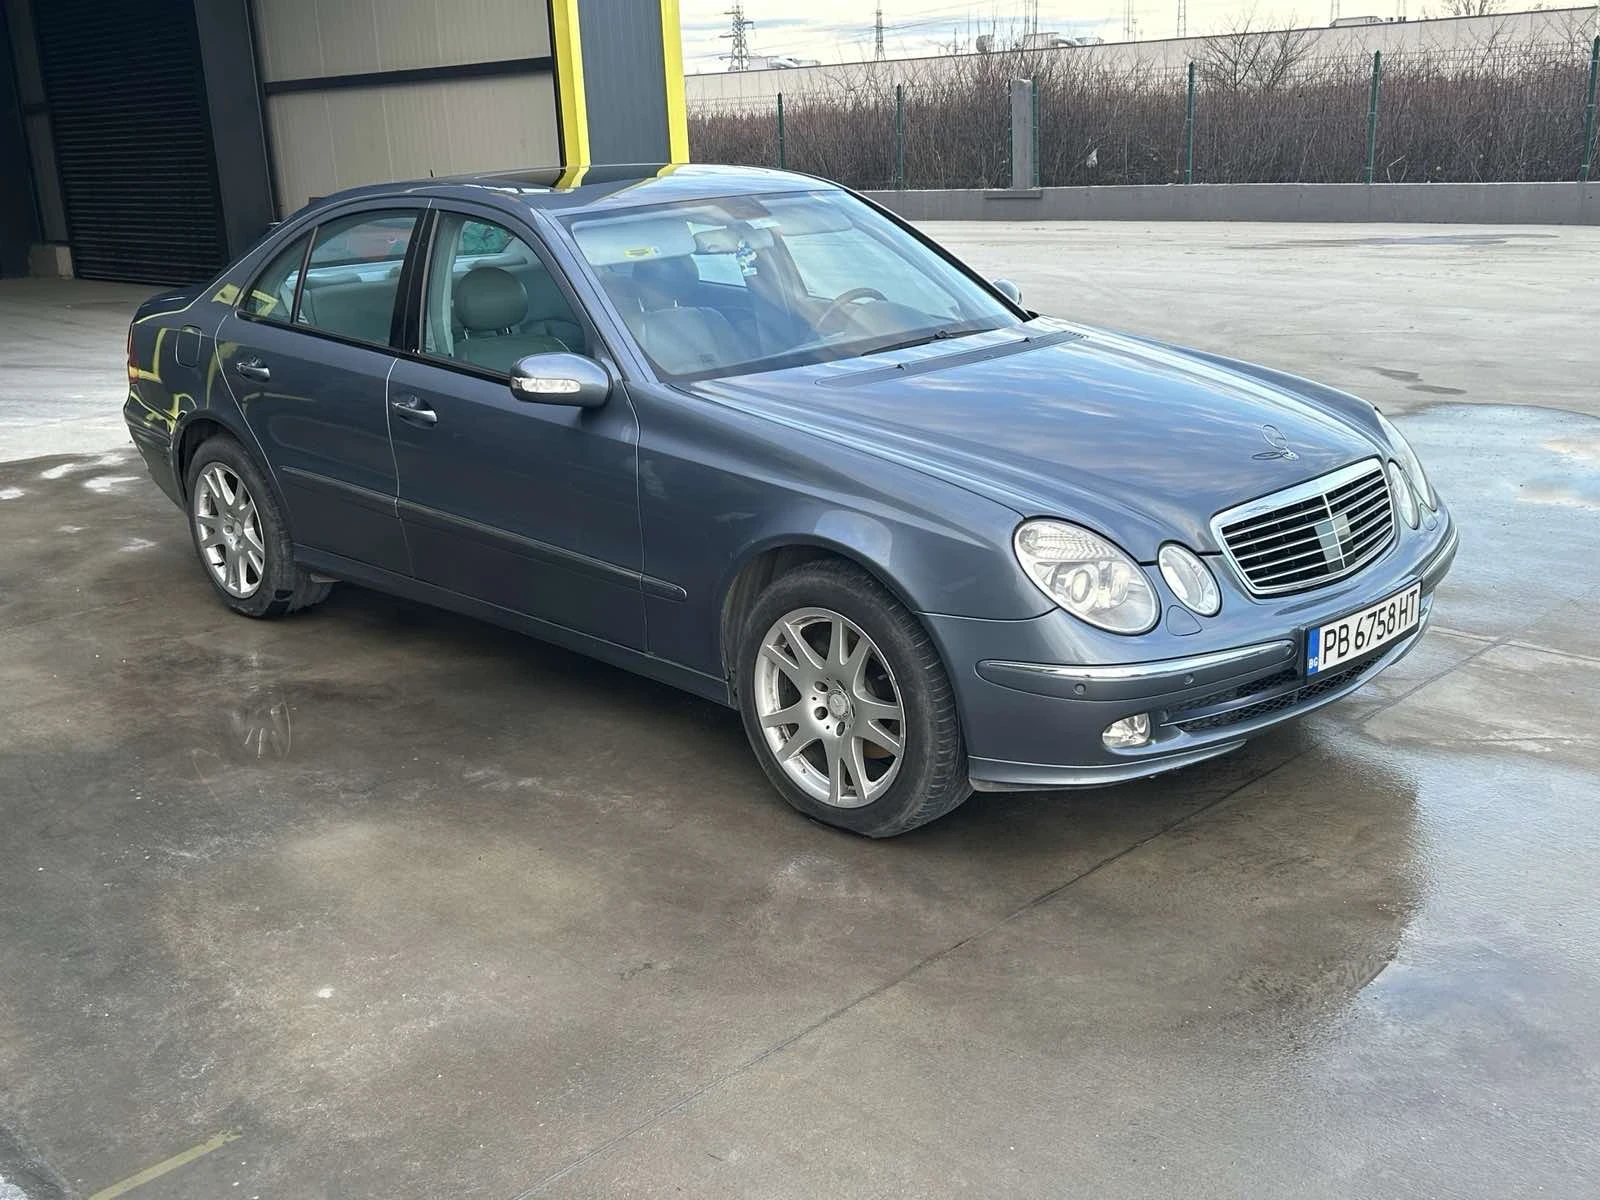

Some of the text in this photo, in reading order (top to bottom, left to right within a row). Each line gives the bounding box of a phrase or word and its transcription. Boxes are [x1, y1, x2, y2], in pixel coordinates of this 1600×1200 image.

[1323, 589, 1418, 664] PB 6758 HT
[1308, 657, 1319, 669] BG
